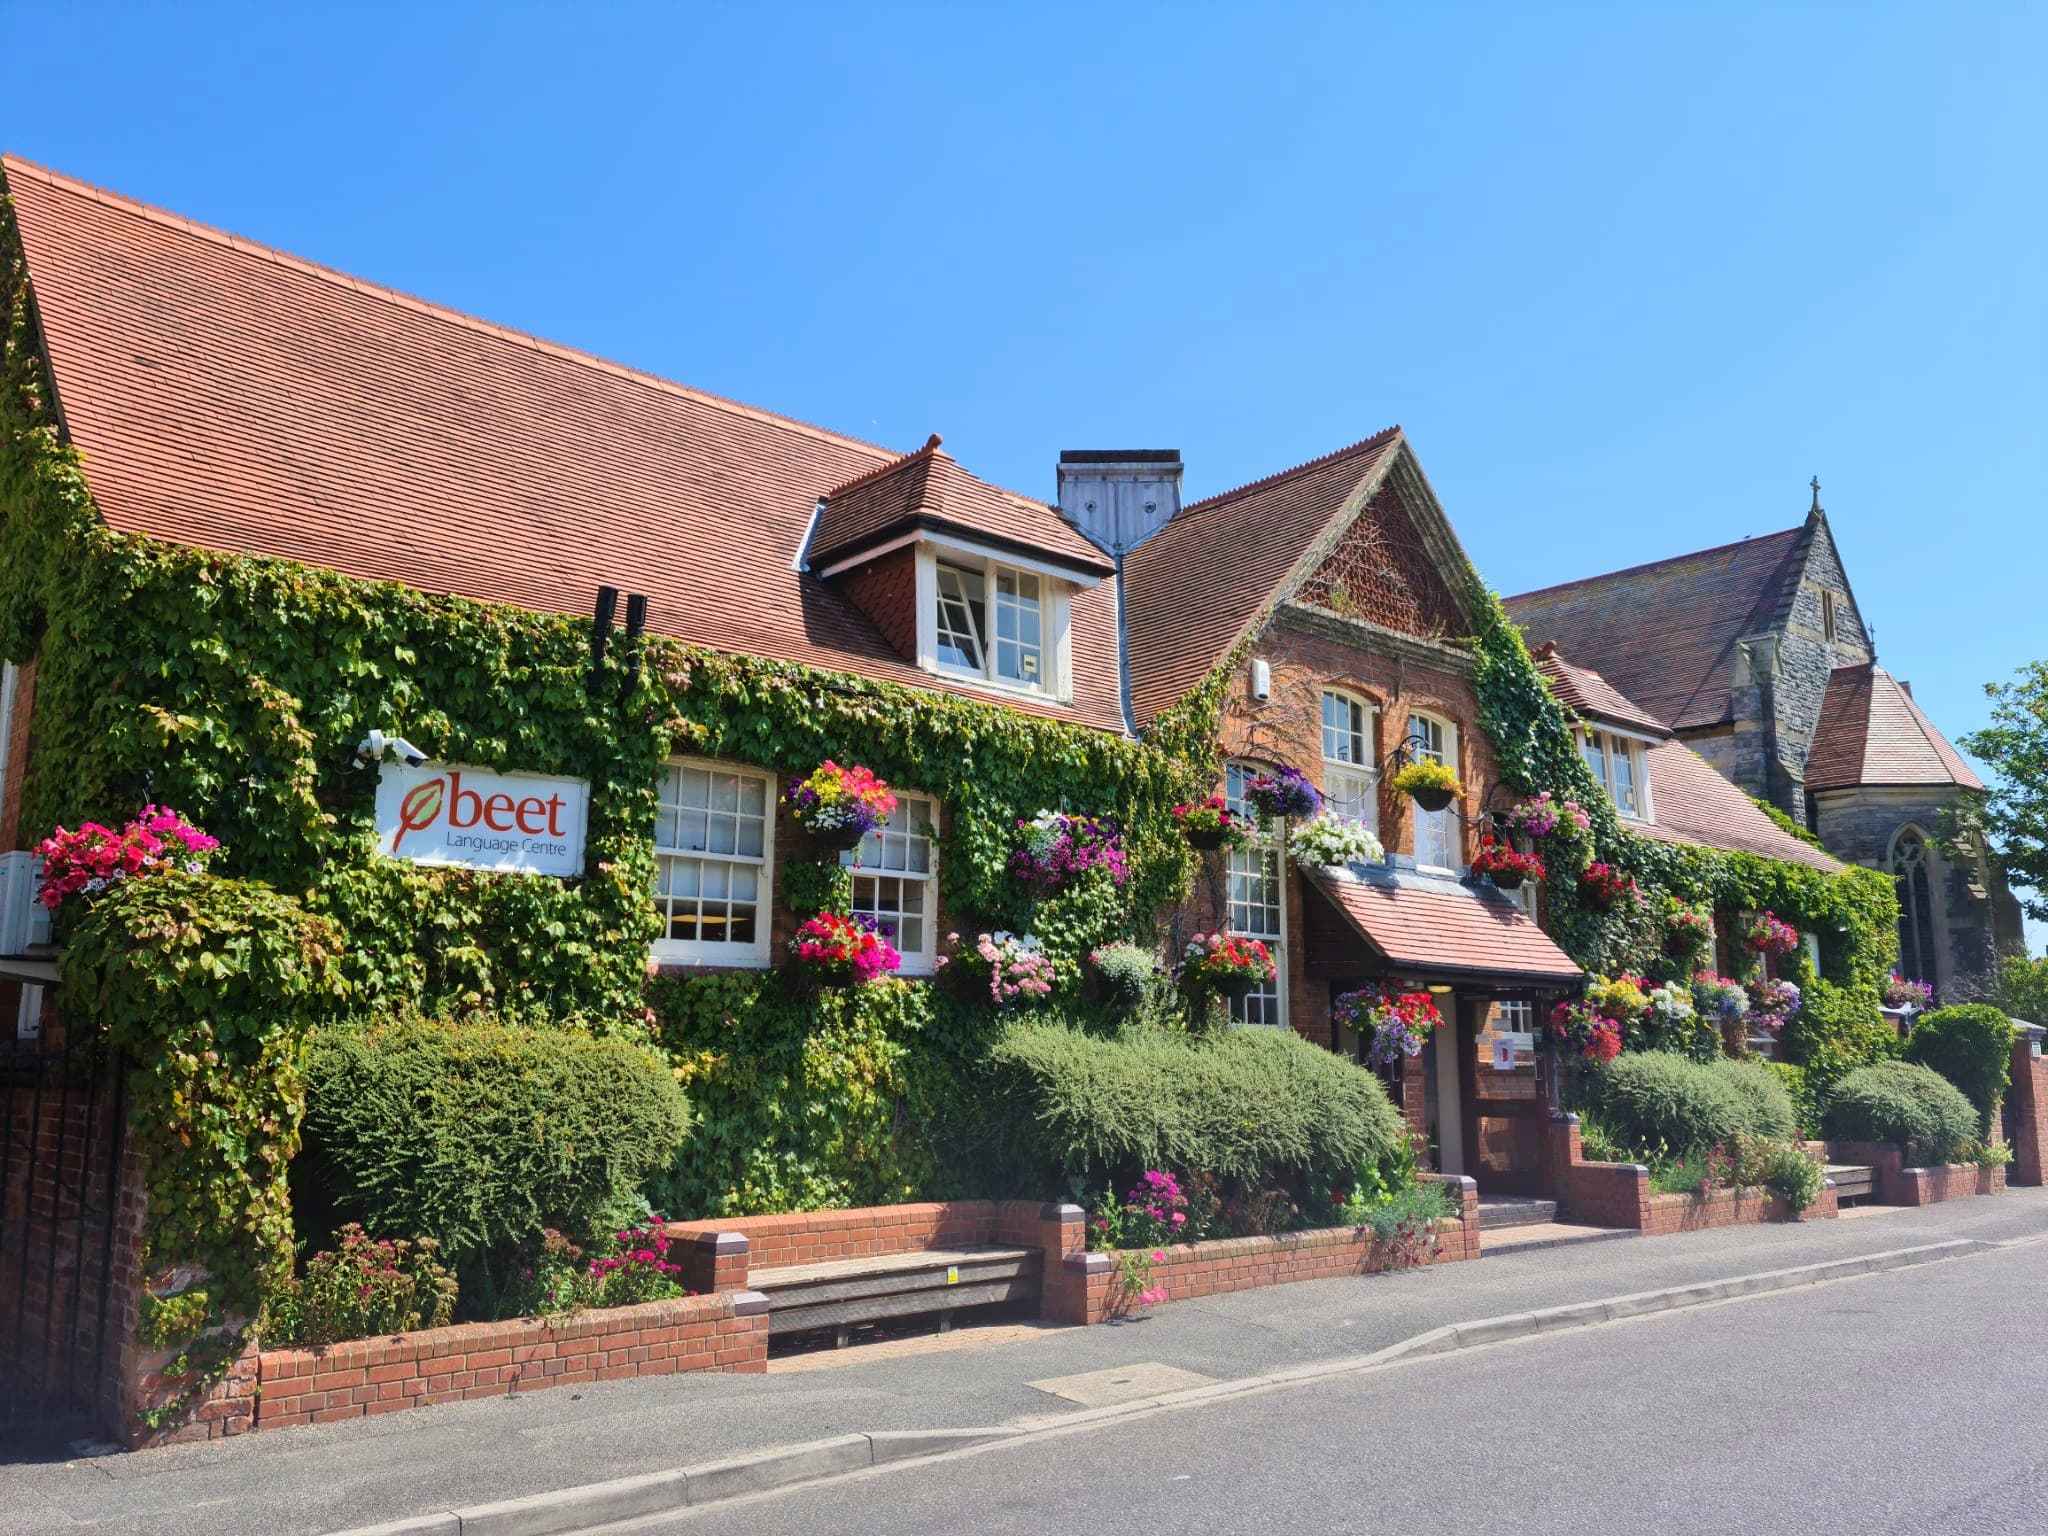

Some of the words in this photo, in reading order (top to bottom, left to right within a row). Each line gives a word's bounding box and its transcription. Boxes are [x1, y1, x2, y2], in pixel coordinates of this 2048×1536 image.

[446, 772, 567, 837] beet
[446, 832, 518, 854] Language
[522, 838, 567, 856] Centre
